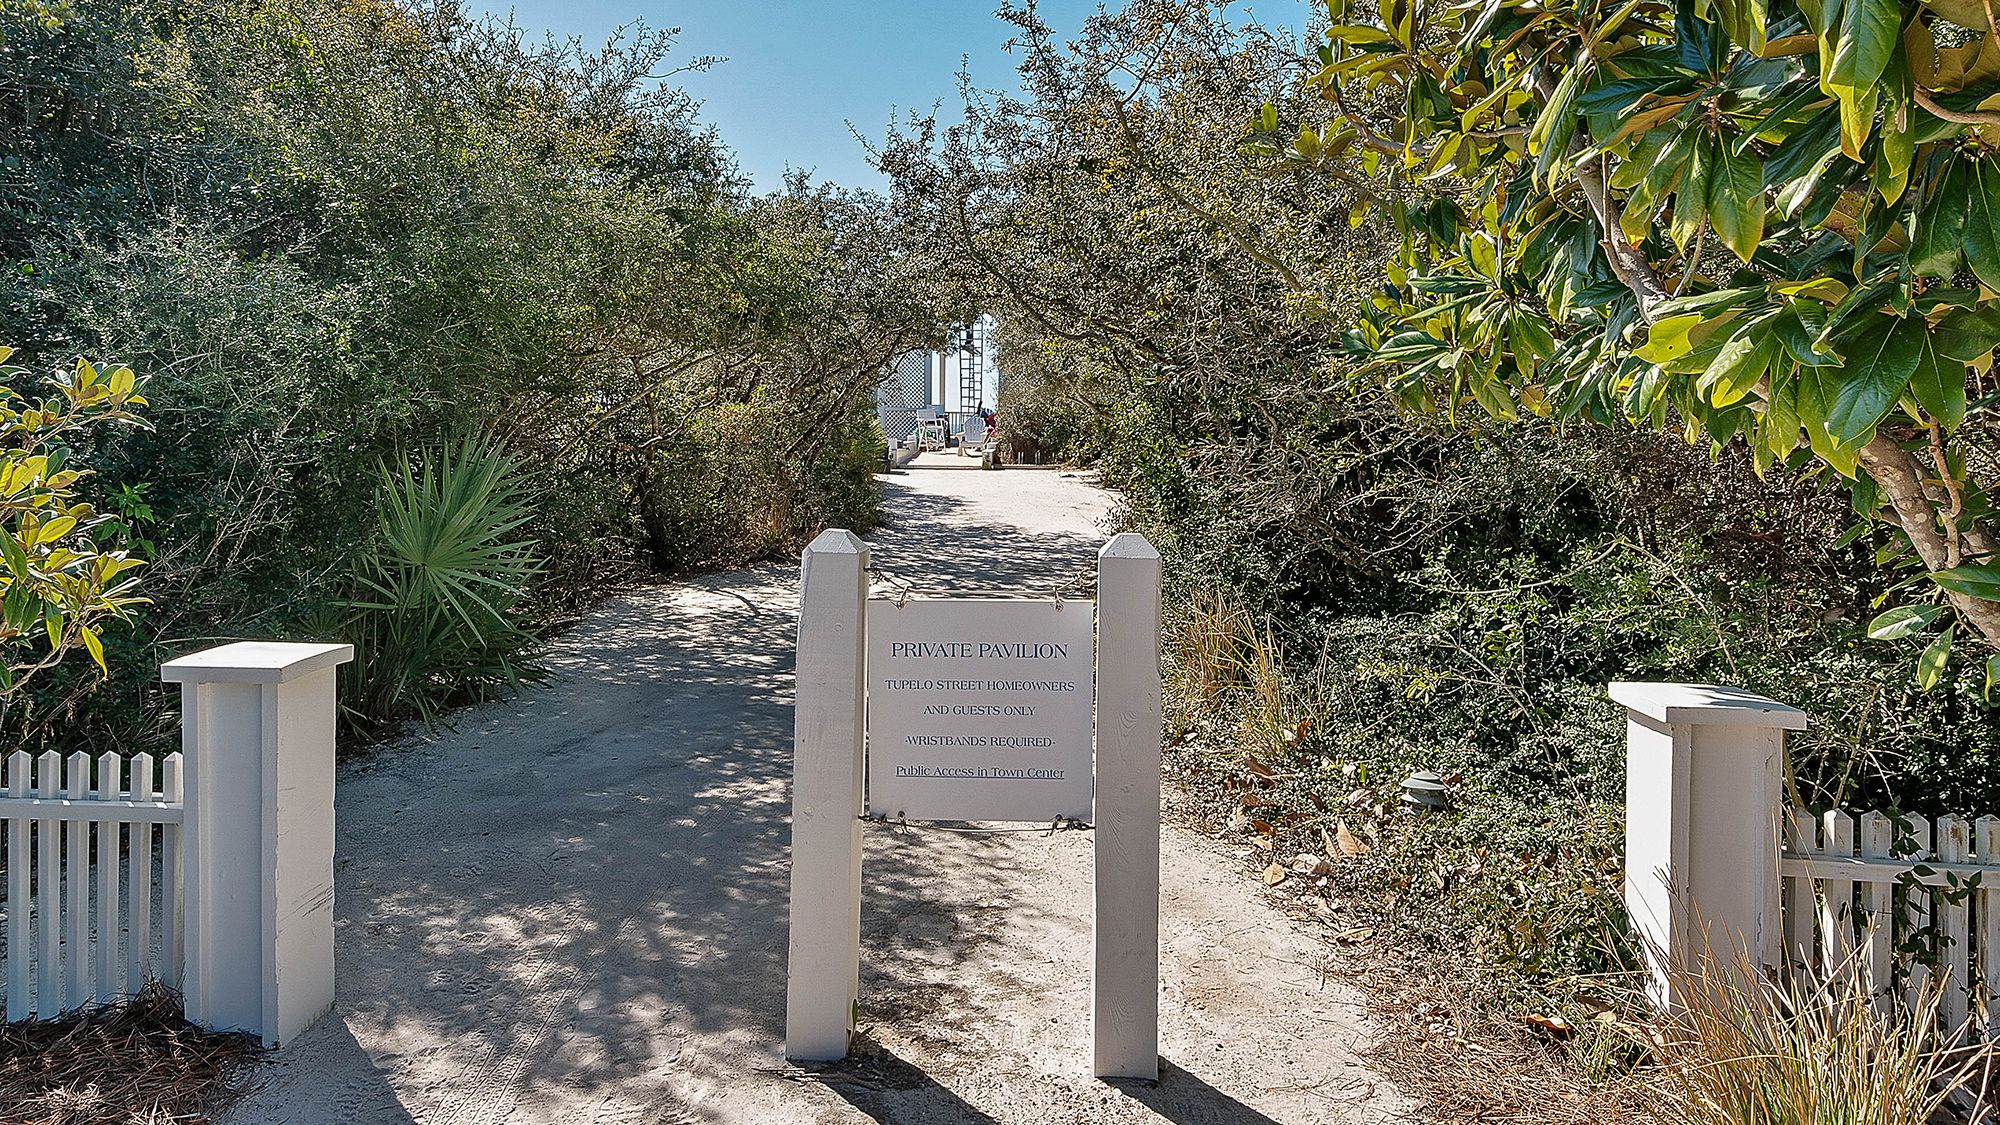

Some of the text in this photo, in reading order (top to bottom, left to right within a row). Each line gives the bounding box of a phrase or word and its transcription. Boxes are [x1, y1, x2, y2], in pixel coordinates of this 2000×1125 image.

[891, 642, 1068, 659] PRIVATE PAVILION
[885, 679, 1075, 692] TUPELO STREET HOMEOWNERS
[923, 705, 1036, 716] AND GUESTS ONLY
[896, 765, 1065, 778] Public Access in Town Center
